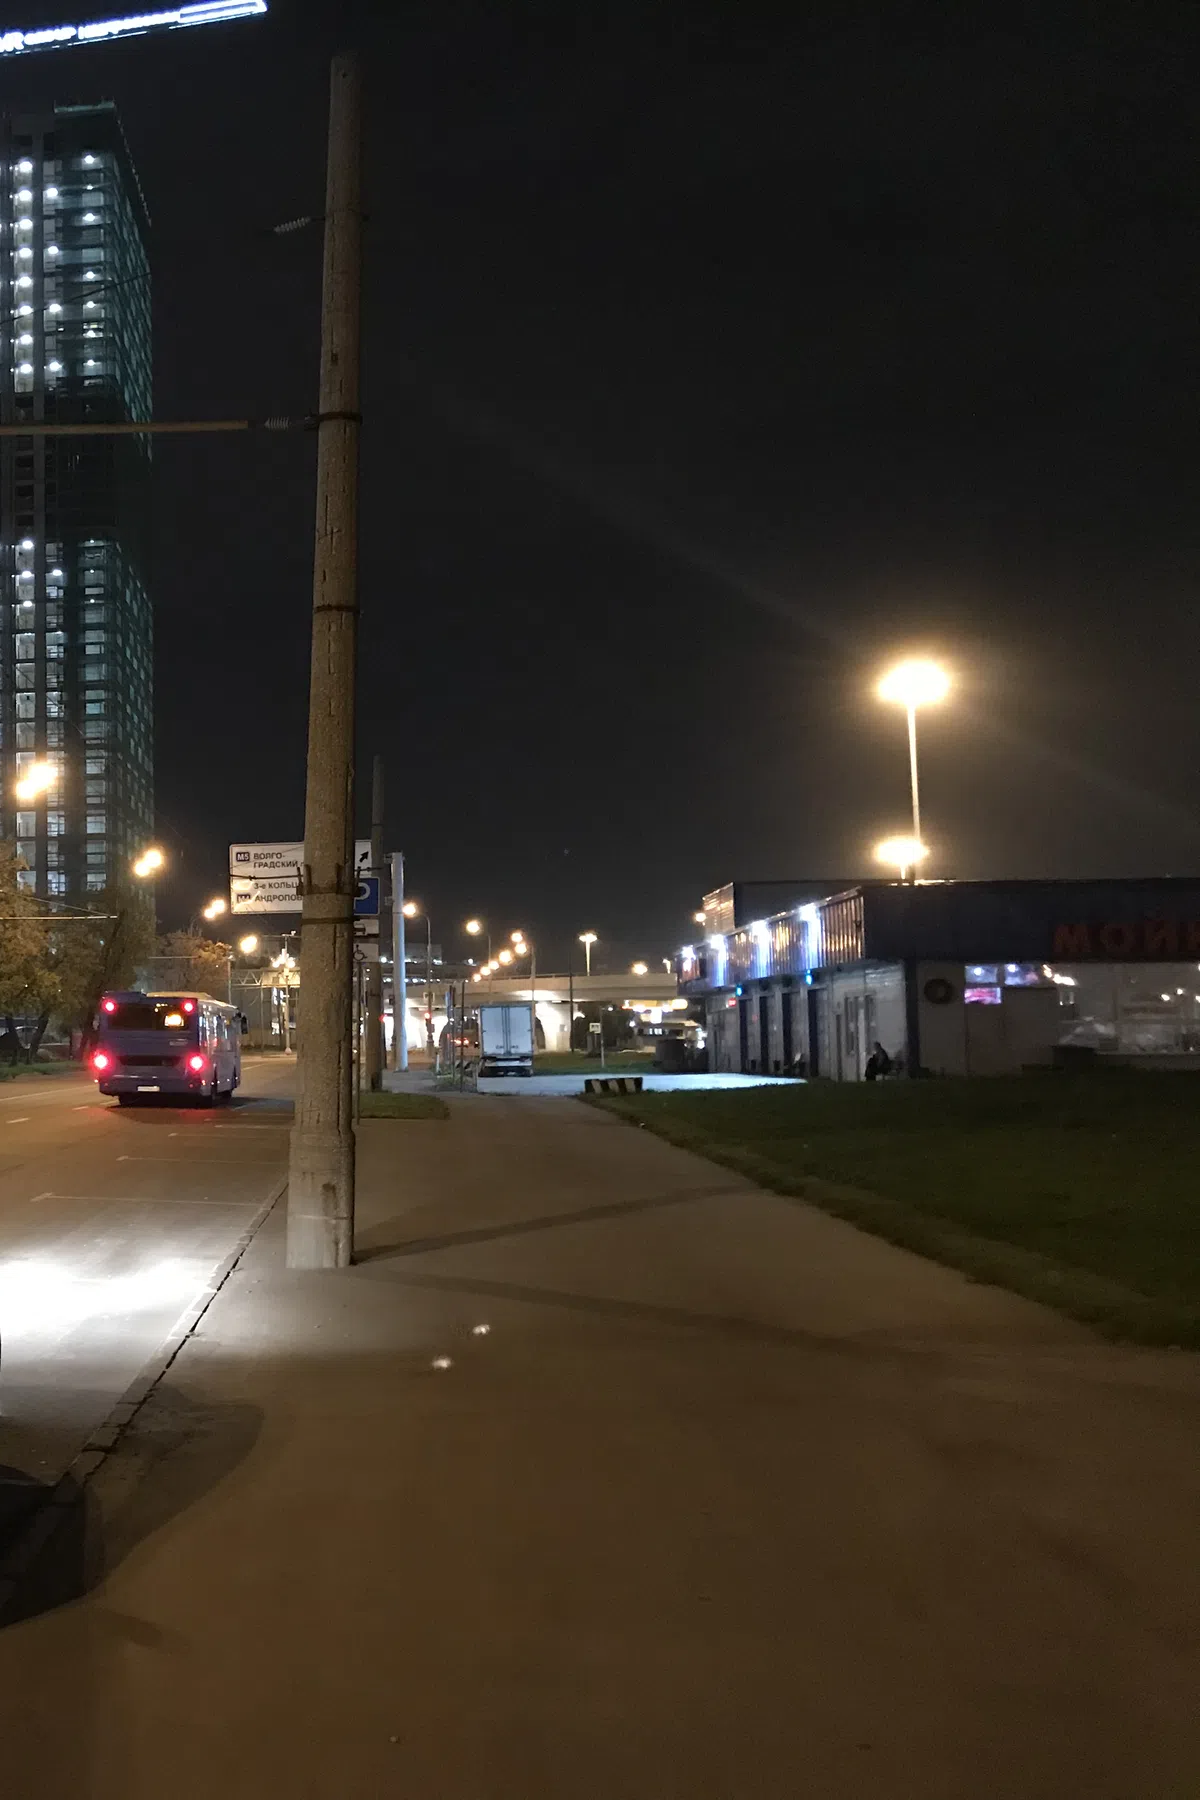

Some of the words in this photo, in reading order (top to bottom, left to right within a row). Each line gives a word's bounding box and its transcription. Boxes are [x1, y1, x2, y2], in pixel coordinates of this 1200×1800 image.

[253, 860, 299, 870] ГРАДСКИЙ
[268, 881, 300, 890] КОЛЬЦ
[254, 893, 303, 903] АНДРОПОВ
